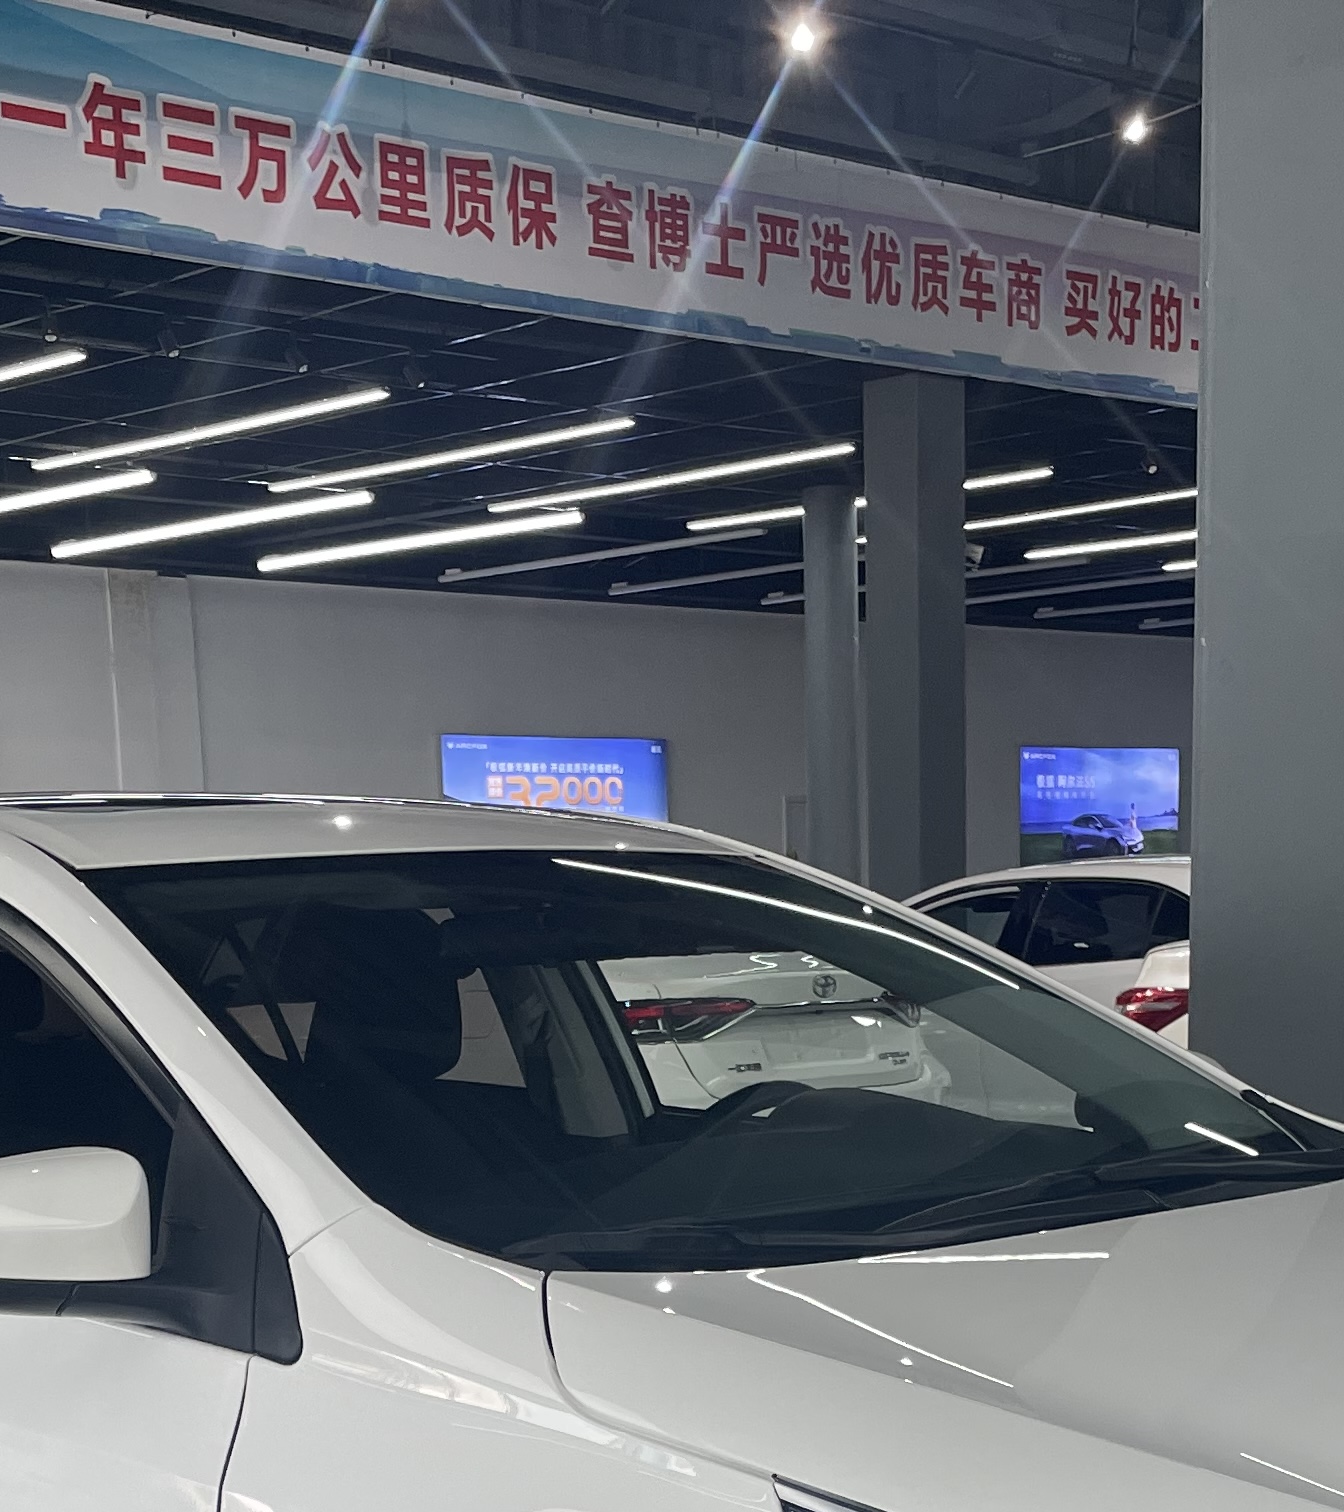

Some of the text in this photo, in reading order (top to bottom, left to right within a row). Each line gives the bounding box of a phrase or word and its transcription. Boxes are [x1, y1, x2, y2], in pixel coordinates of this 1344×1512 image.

[0, 81, 1201, 352] 一年三万公里质保 查博士严选优质车商 买好的
